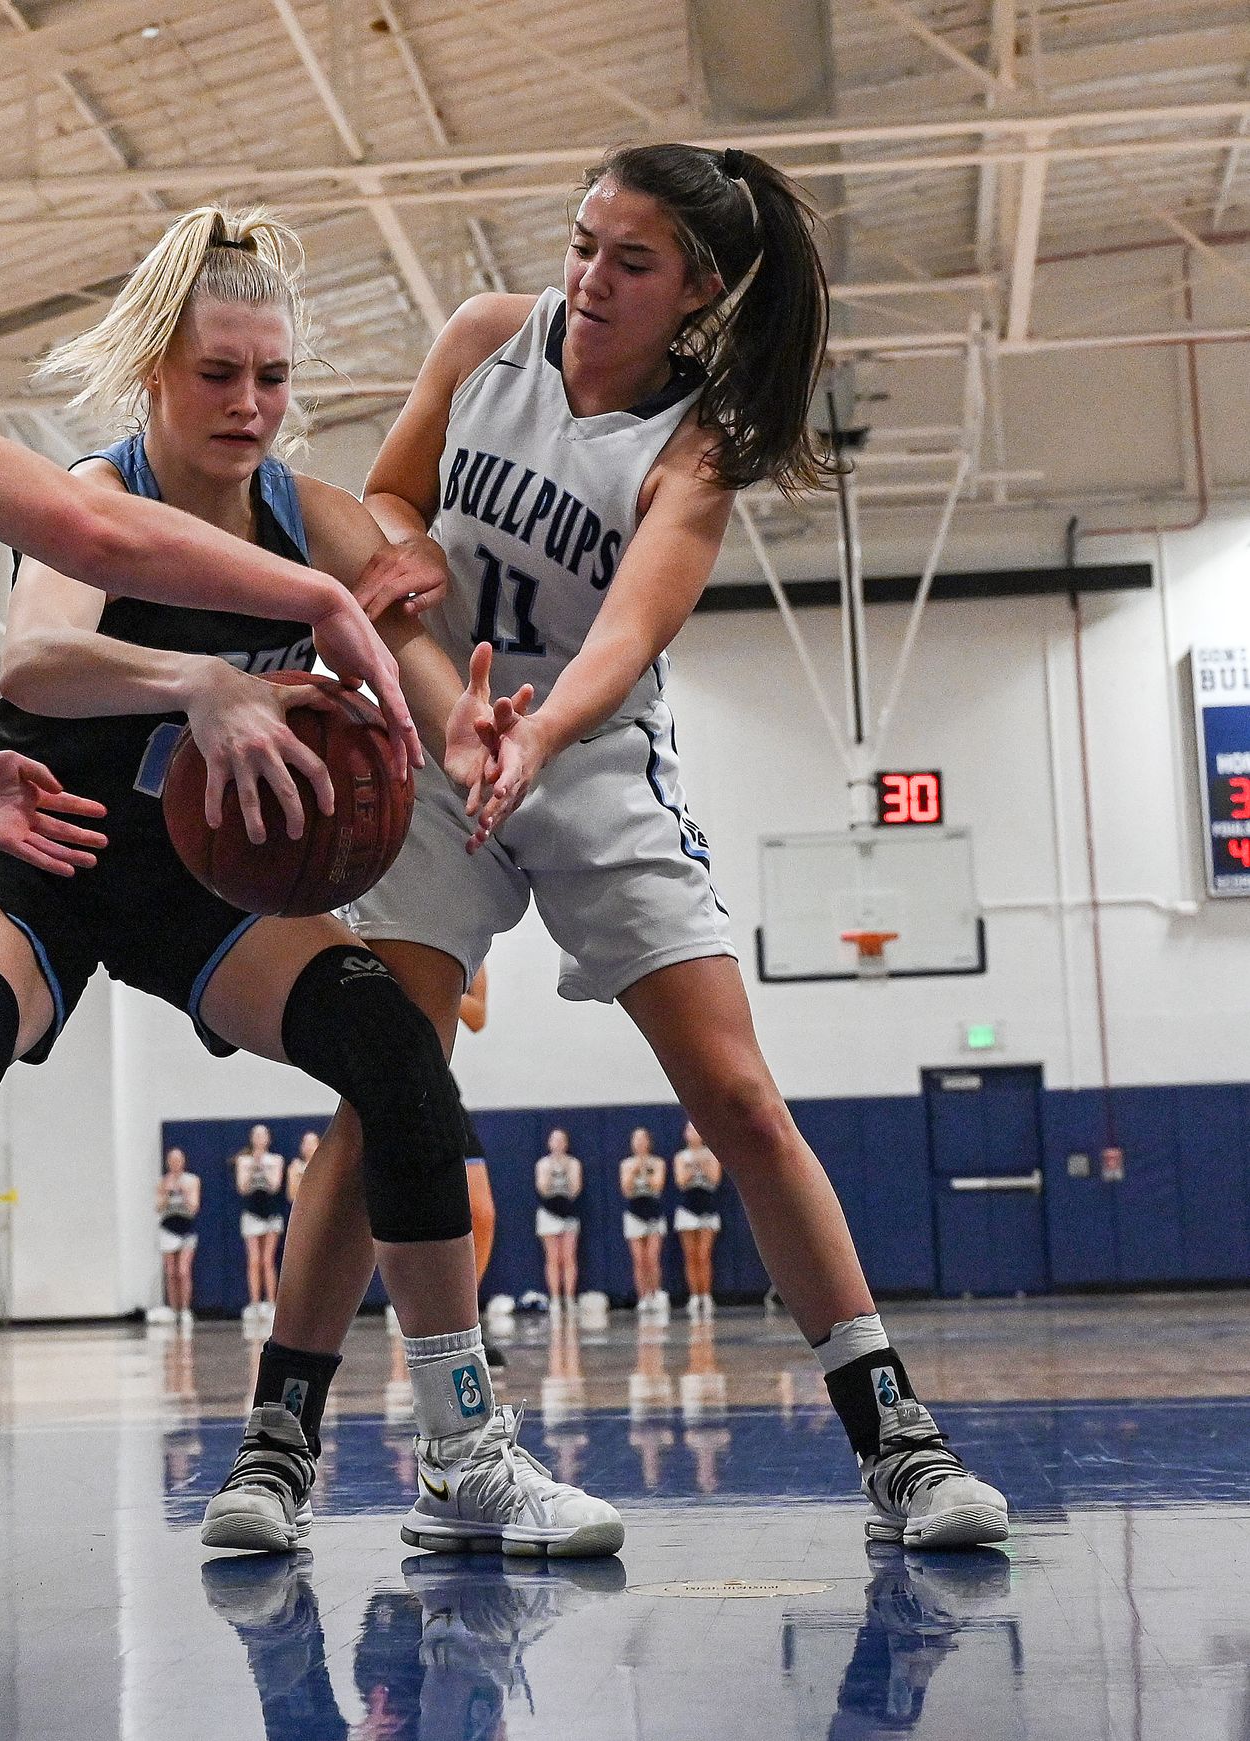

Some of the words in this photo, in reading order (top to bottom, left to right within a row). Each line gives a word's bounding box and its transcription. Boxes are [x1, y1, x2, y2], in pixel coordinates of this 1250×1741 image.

[443, 447, 622, 591] BULLPUPS
[470, 543, 547, 657] 11
[882, 773, 940, 823] 30
